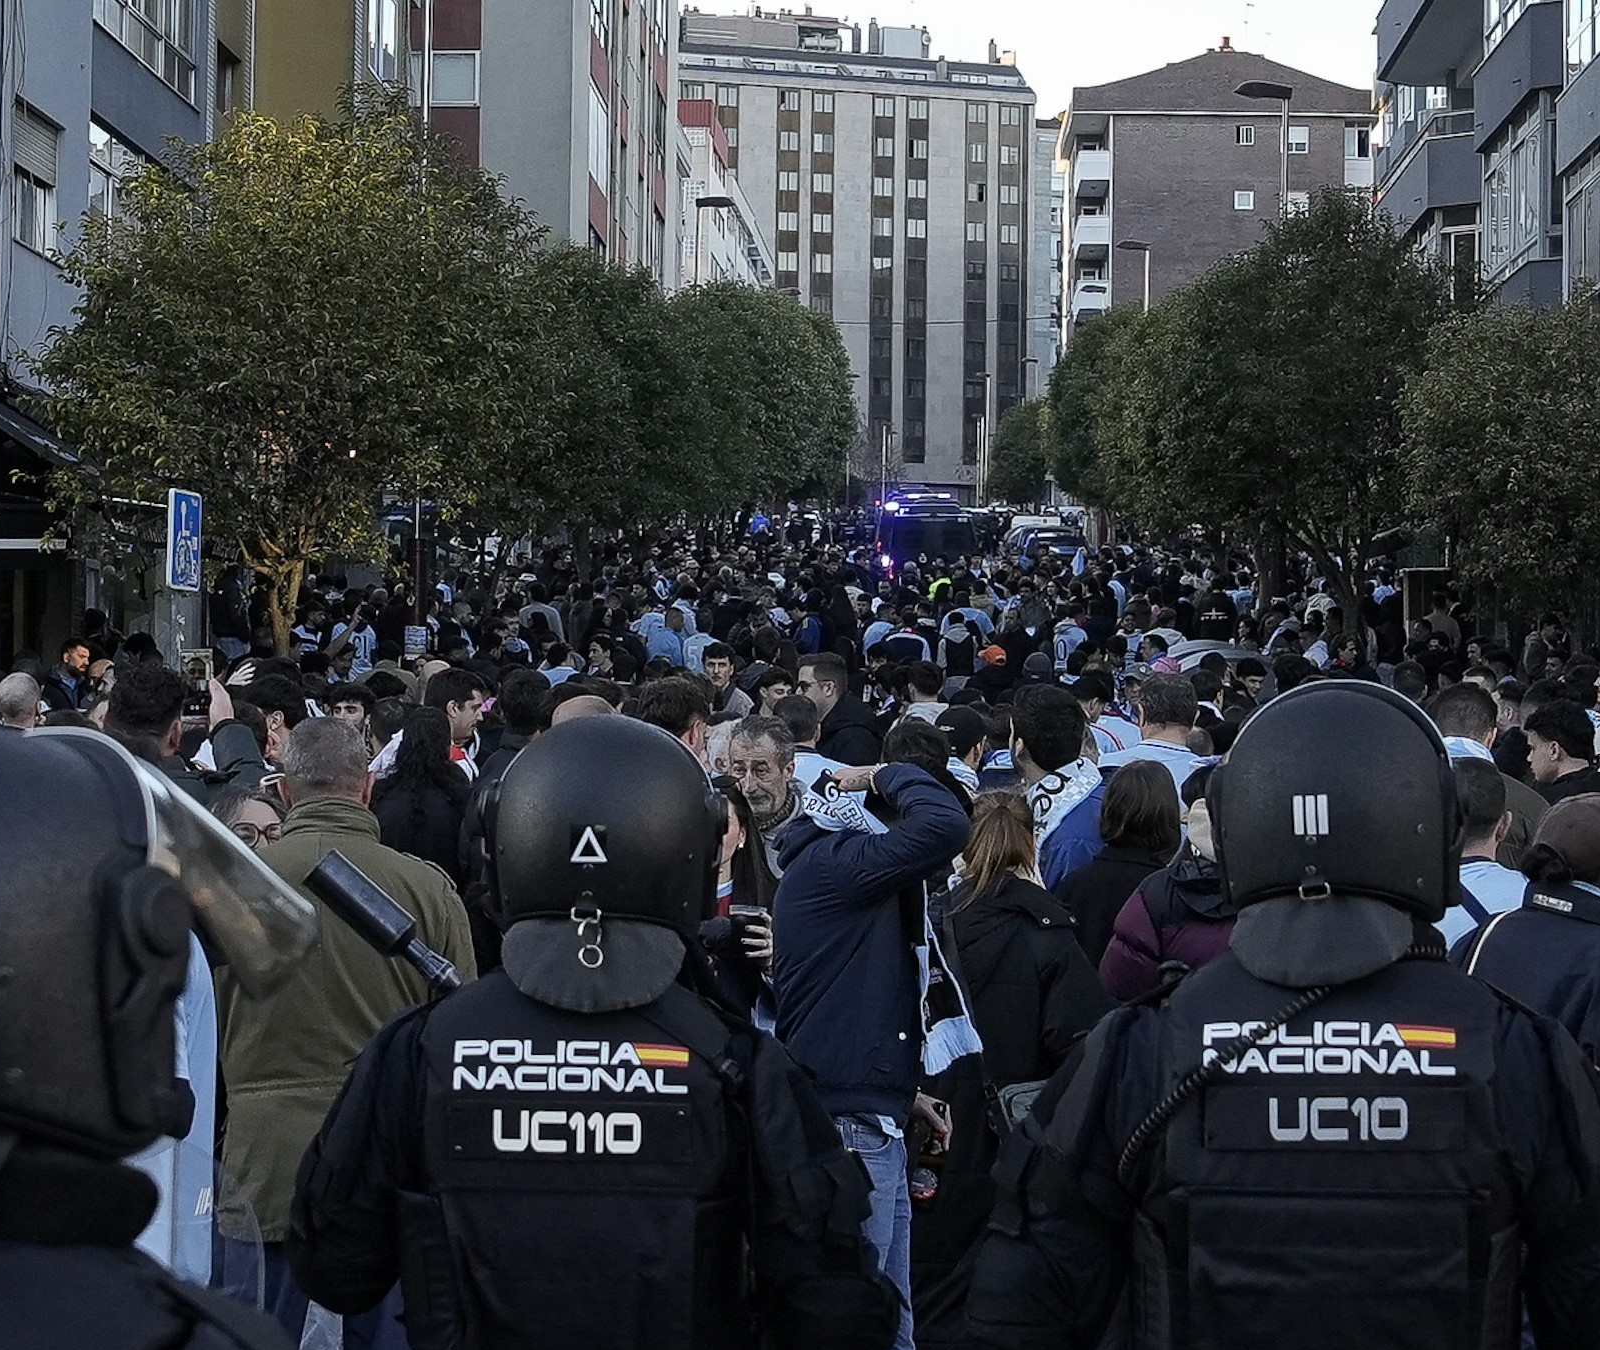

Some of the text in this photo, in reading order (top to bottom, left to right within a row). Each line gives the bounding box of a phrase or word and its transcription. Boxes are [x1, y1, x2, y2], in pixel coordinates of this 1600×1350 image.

[1203, 1021, 1405, 1047] POLICIA
[454, 1038, 641, 1066] POLICIA
[1202, 1047, 1457, 1076] NACIONAL
[452, 1065, 689, 1095] NACIONAL
[492, 1108, 642, 1155] UC110
[1268, 1096, 1409, 1141] UC10
